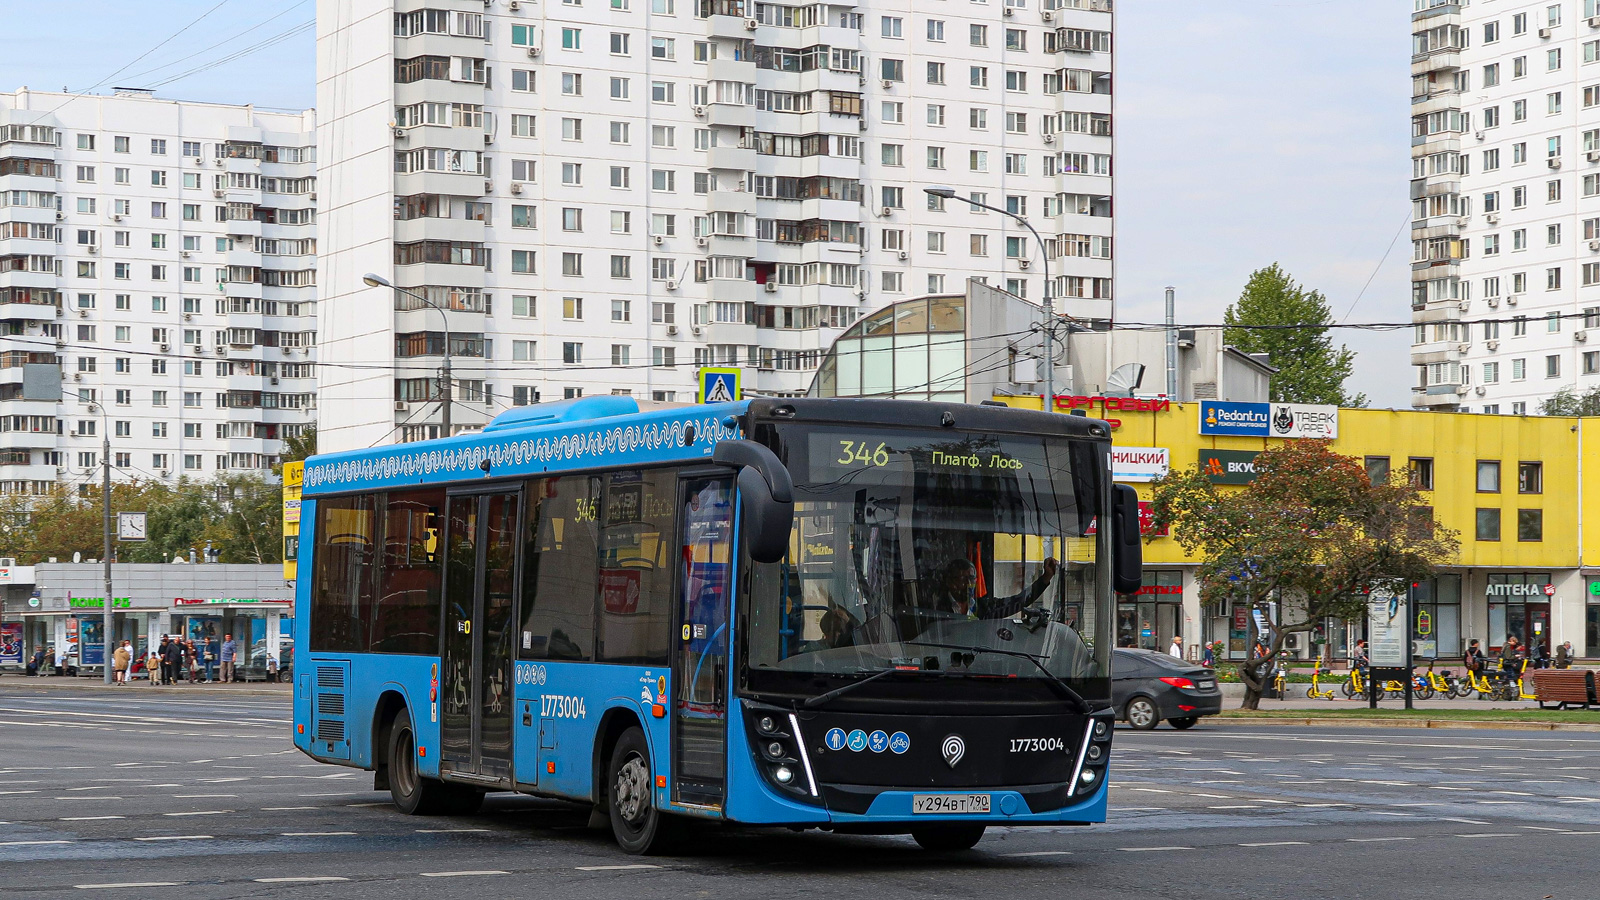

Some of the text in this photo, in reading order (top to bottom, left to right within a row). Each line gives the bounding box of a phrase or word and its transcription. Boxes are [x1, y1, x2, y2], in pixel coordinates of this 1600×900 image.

[1218, 409, 1268, 422] Pedant.ru
[1295, 411, 1335, 423] ТАБАК
[1296, 424, 1324, 433] VAPE
[837, 440, 889, 467] 346
[932, 451, 1023, 470] Платф. Лось
[1111, 449, 1165, 464] НИЦКИЙ
[574, 498, 596, 523] 346
[1485, 583, 1540, 596] АПТЕКА
[70, 597, 130, 608] ЛОМБРД
[540, 694, 587, 719] 1773004
[1009, 737, 1064, 753] 1773004
[917, 796, 987, 811] У294ВТ 790
